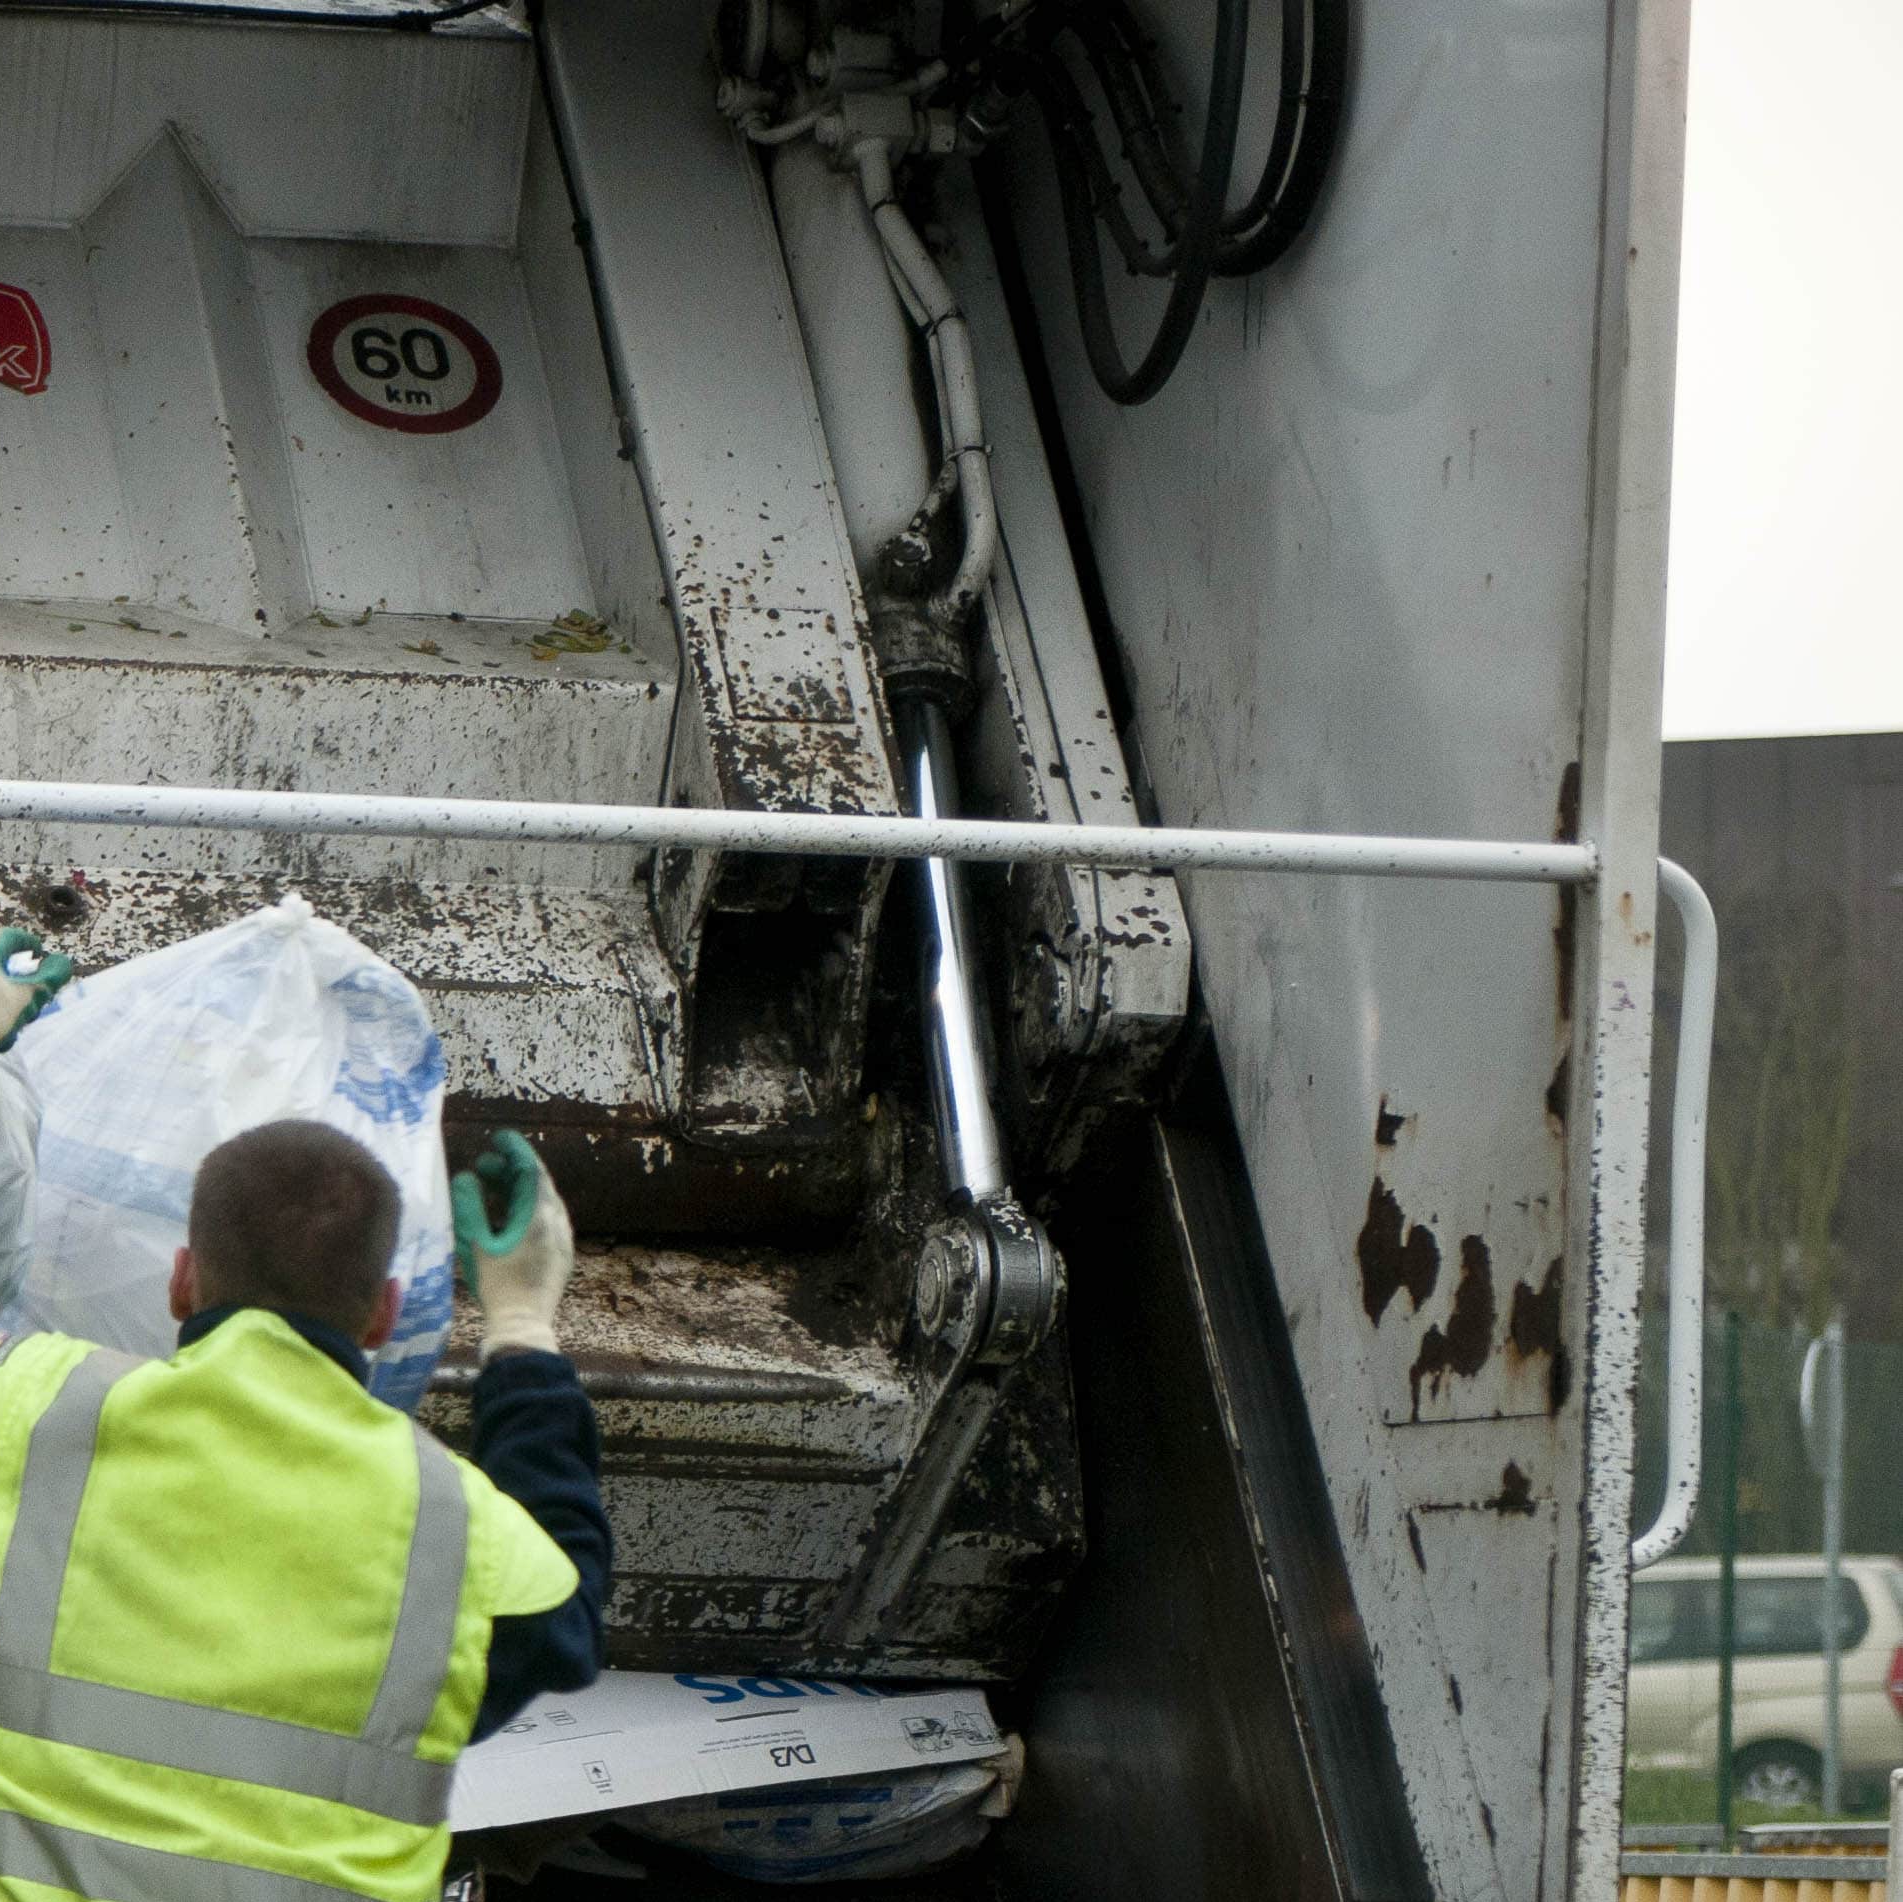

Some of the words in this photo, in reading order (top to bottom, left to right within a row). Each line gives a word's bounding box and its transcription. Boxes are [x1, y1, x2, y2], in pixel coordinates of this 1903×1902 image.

[351, 327, 451, 381] 60
[385, 384, 432, 405] km
[769, 1743, 817, 1768] DVB
